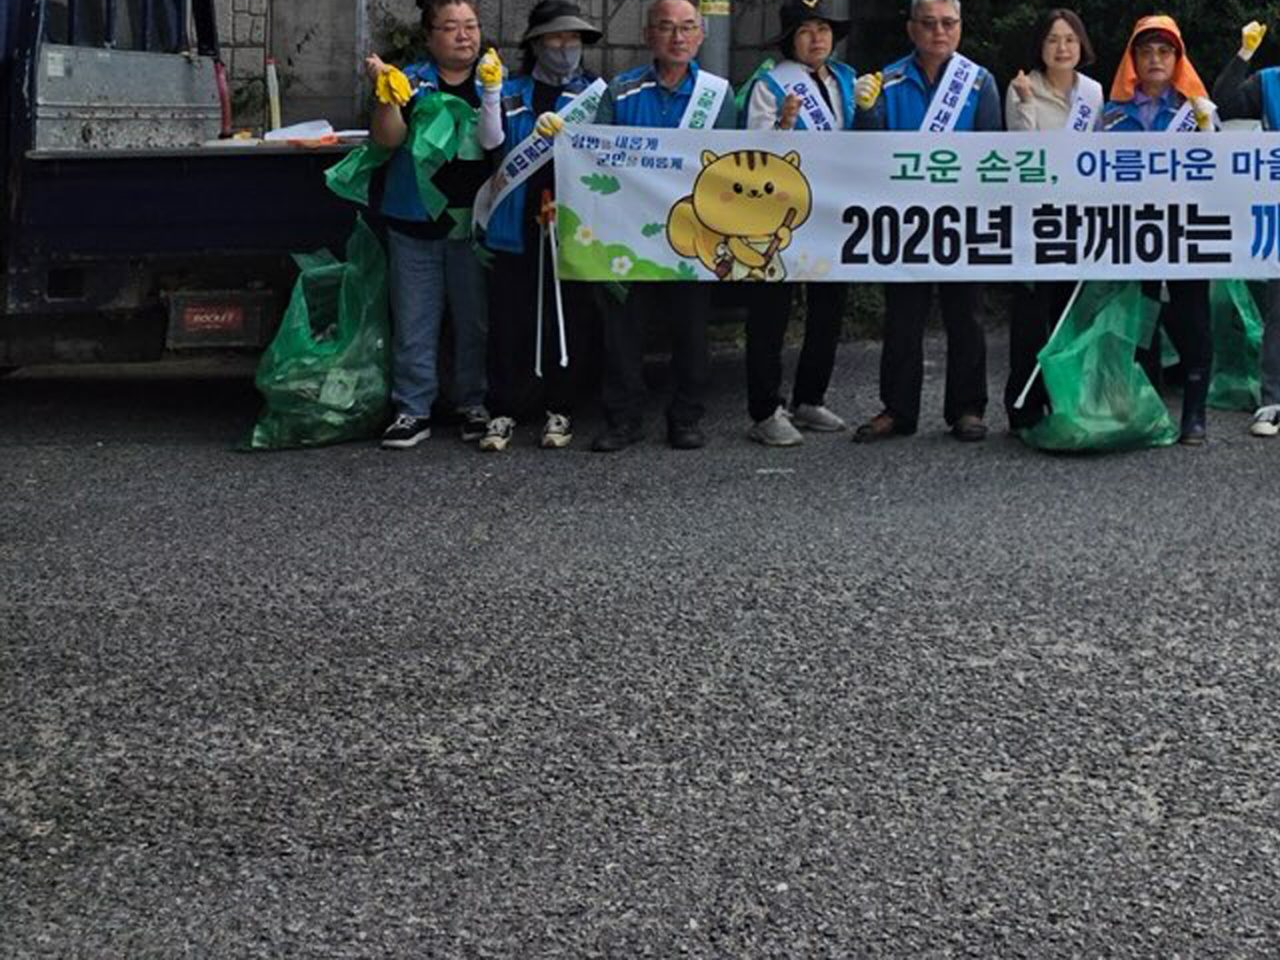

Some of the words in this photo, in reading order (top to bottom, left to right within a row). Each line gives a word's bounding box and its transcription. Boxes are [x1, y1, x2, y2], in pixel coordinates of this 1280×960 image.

[930, 109, 952, 132] 새단
[1073, 105, 1091, 132] 우리
[890, 149, 962, 183] 고운
[976, 148, 1059, 185] 손길,
[1076, 147, 1217, 183] 아름다운
[841, 204, 1014, 267] 2026년
[1032, 203, 1232, 266] 함께하는
